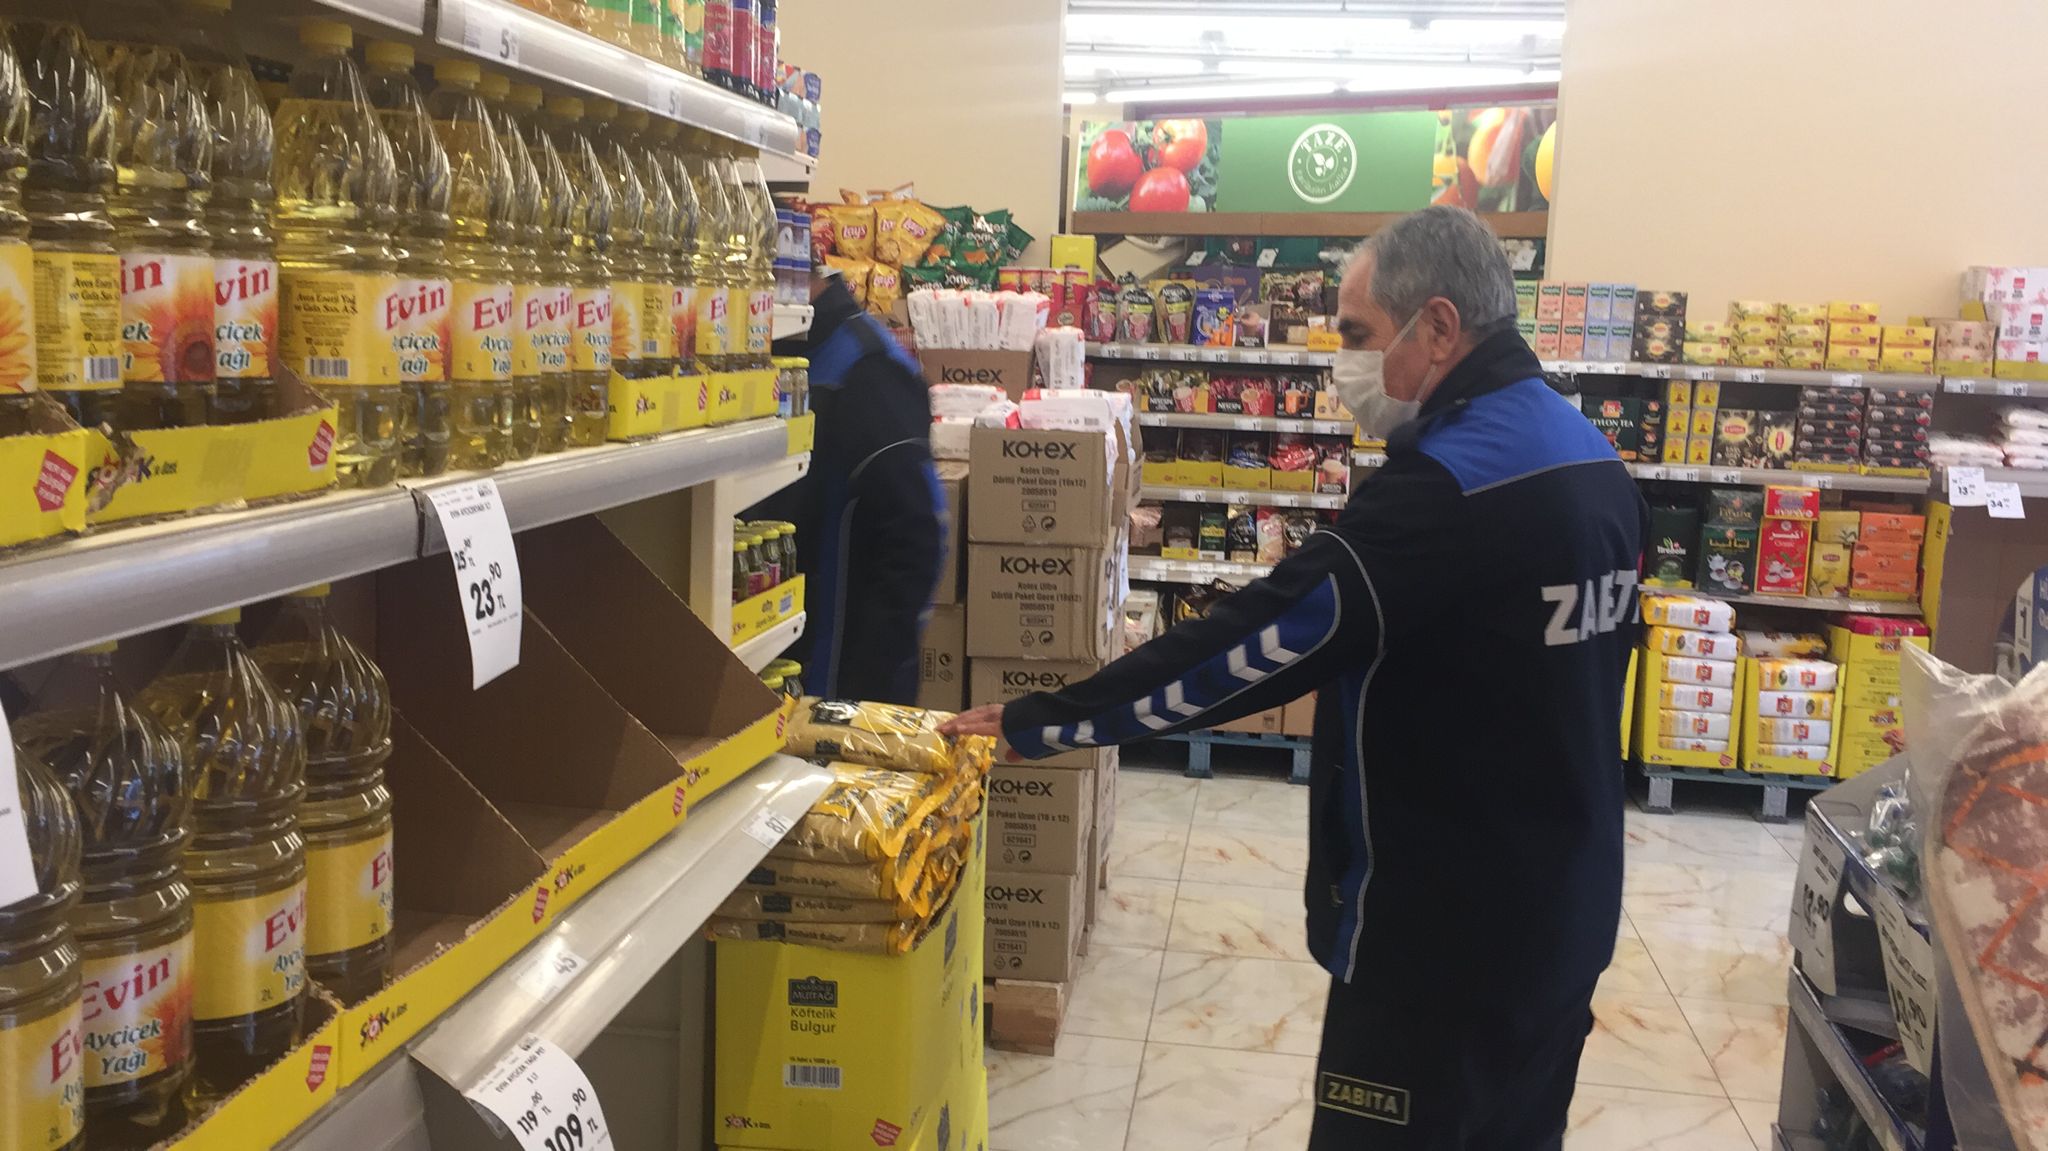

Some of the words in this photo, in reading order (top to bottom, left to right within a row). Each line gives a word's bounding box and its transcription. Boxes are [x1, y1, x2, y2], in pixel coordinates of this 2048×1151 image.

[1300, 131, 1347, 153] TAZE
[473, 292, 512, 333] Evi
[577, 294, 611, 329] Evi
[942, 364, 1004, 384] kotex
[1002, 439, 1077, 461] kotex
[1000, 555, 1074, 576] kotex
[470, 578, 497, 621] 23
[1001, 669, 1069, 688] kotex
[790, 1007, 837, 1020] Köftelik
[790, 1020, 837, 1035] Bulgur
[1326, 1081, 1399, 1115] ZABITA
[517, 1110, 540, 1135] 119
[544, 1113, 584, 1151] 109
